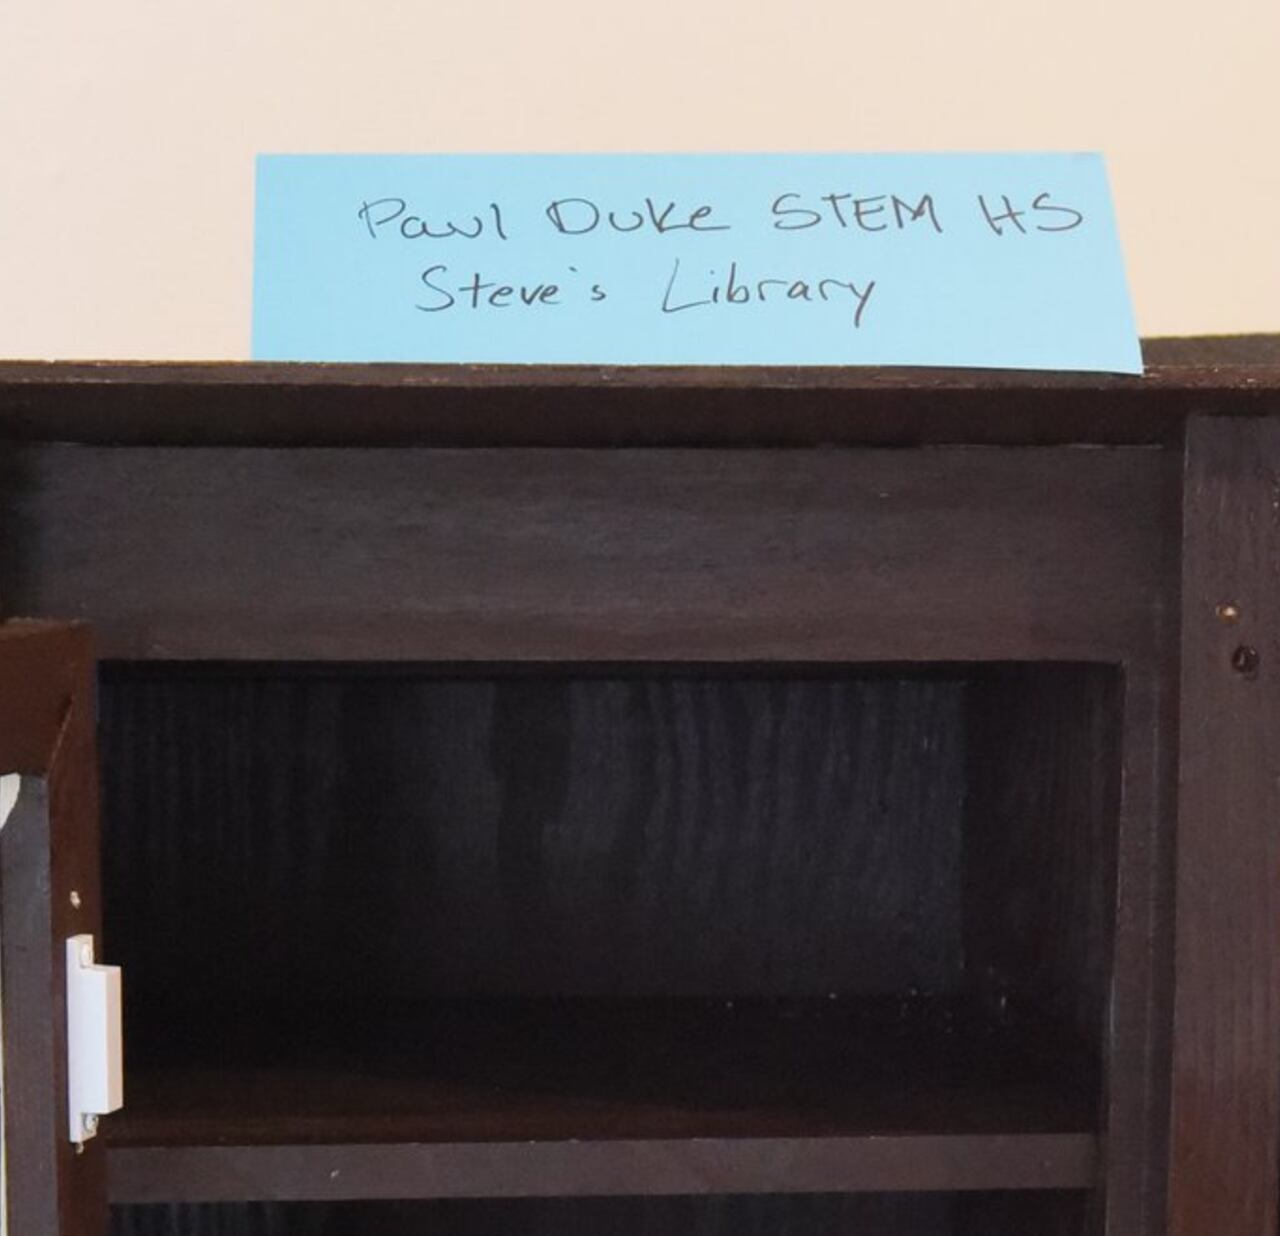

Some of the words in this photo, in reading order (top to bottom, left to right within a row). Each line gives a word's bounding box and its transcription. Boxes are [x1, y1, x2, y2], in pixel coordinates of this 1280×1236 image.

[359, 197, 509, 242] Paul
[547, 197, 733, 236] Duke
[771, 192, 944, 236] STEM
[978, 193, 1084, 235] HS
[414, 264, 609, 313] Steve's
[661, 257, 878, 328] Library
